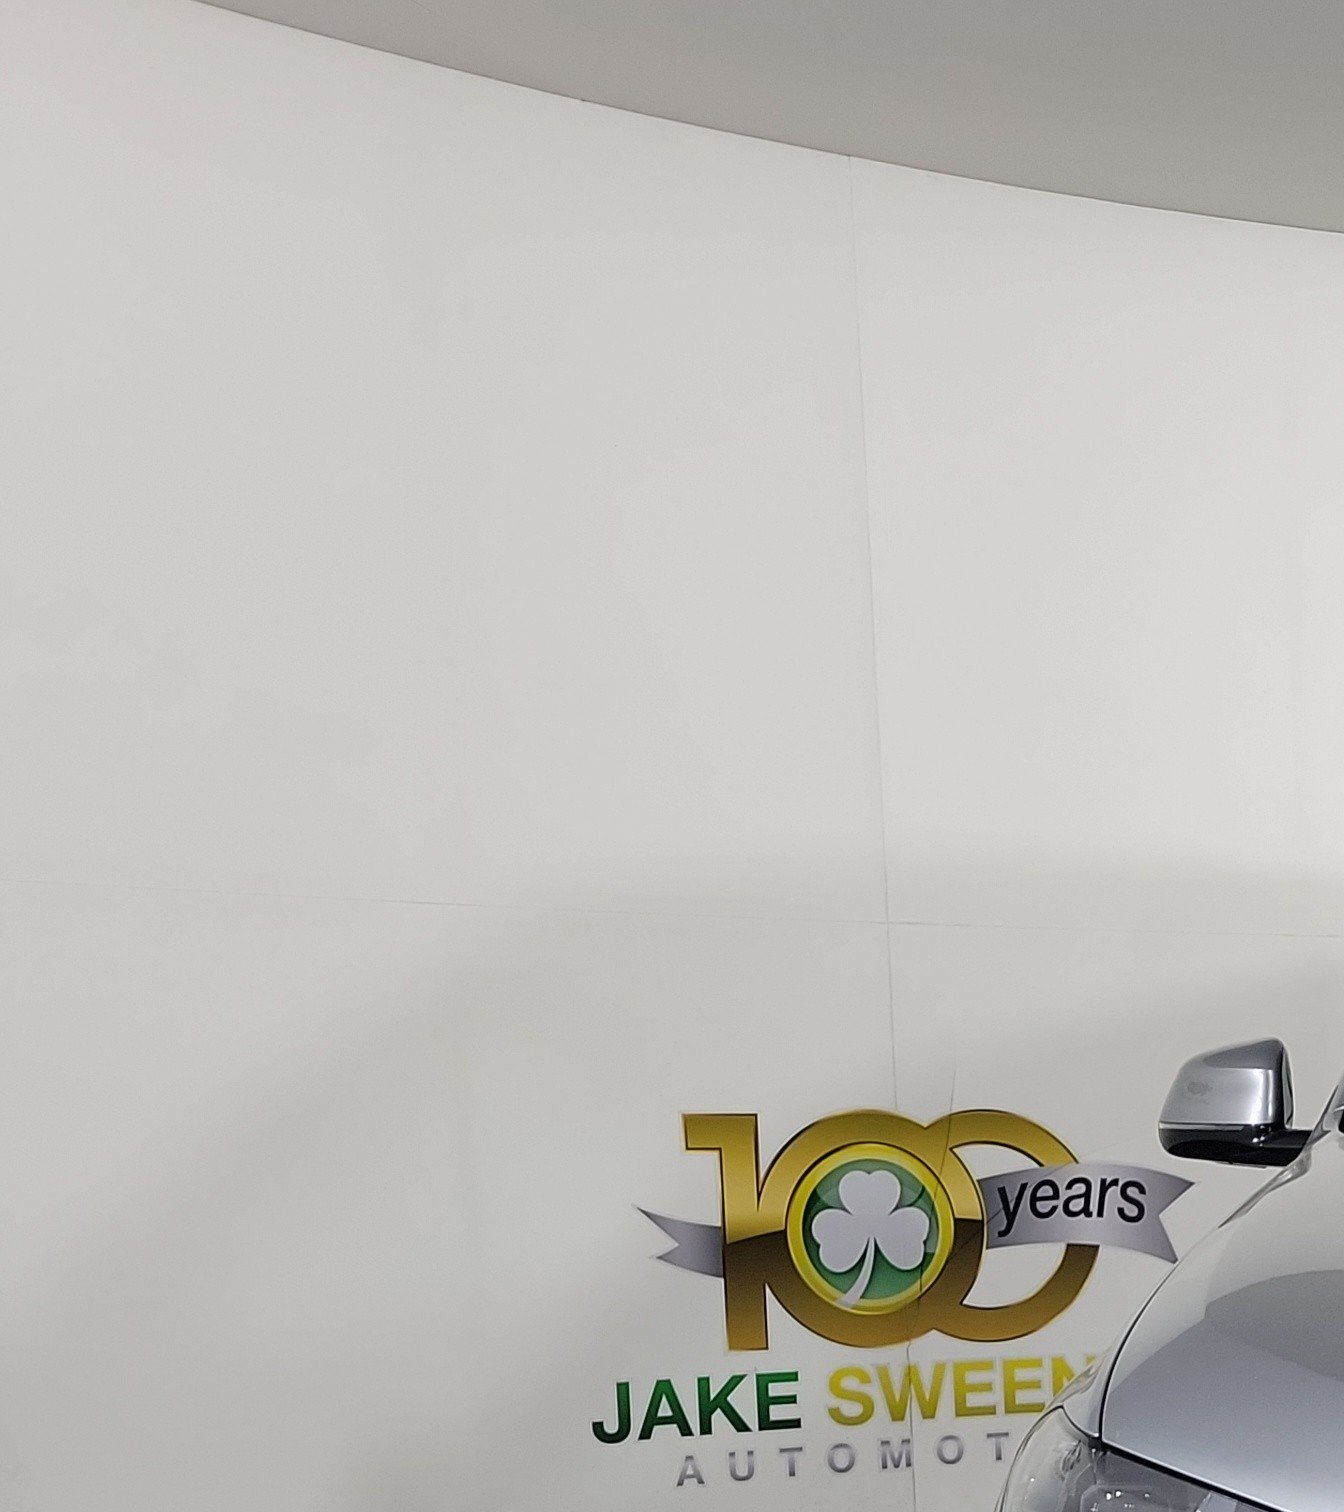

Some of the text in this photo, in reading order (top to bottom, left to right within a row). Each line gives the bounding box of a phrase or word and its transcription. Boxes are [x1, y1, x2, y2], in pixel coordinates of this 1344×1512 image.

[682, 1108, 1147, 1351] 100 years
[591, 1354, 1097, 1444] JAKE SWEE
[676, 1432, 1009, 1487] AUTOMOT
